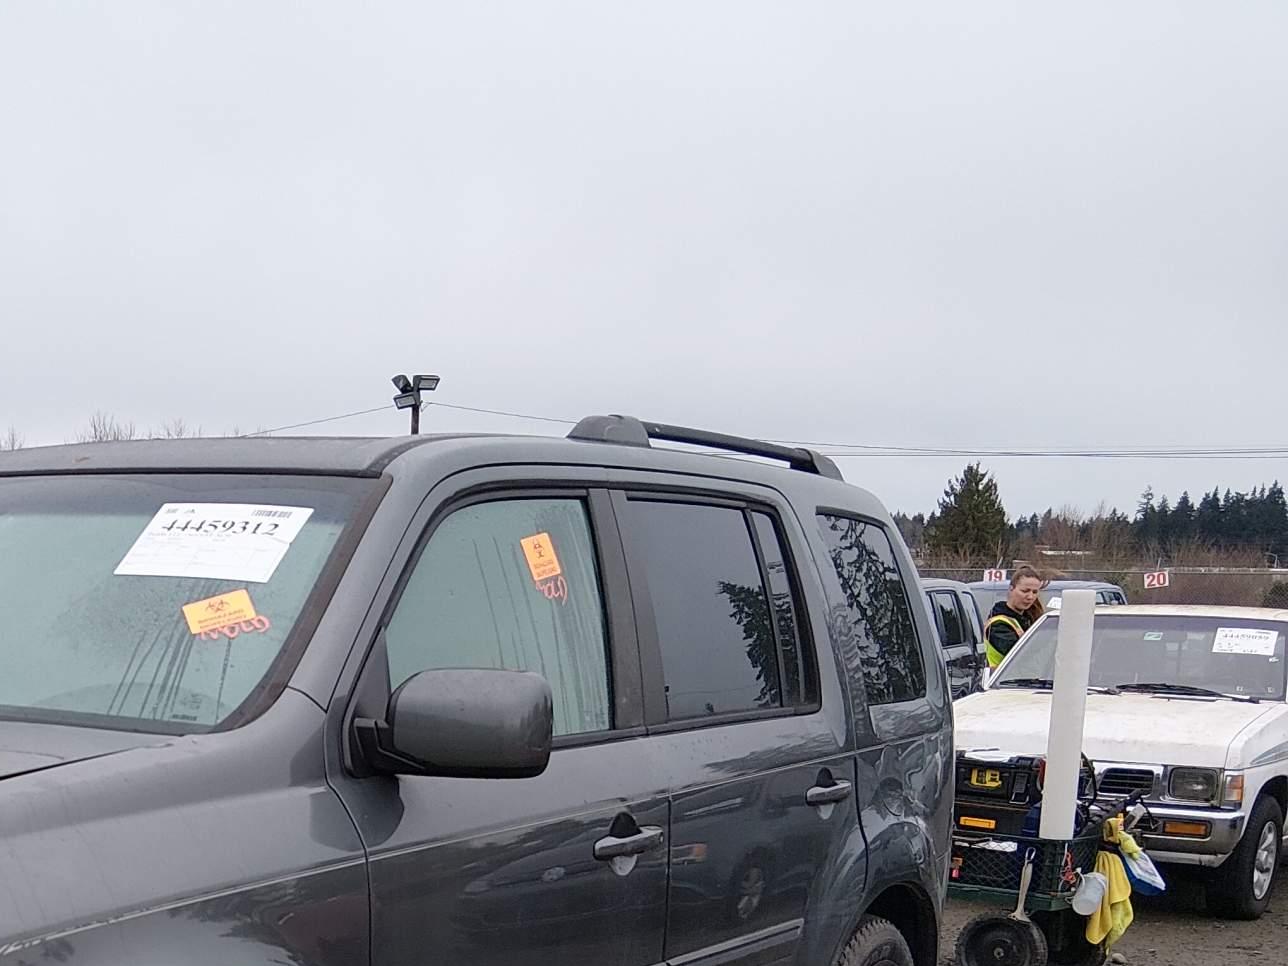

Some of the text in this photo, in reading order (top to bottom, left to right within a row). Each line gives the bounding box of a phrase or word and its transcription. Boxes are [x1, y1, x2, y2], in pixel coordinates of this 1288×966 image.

[162, 518, 280, 536] 44459312
[986, 570, 1004, 582] 19
[1146, 572, 1167, 587] 20
